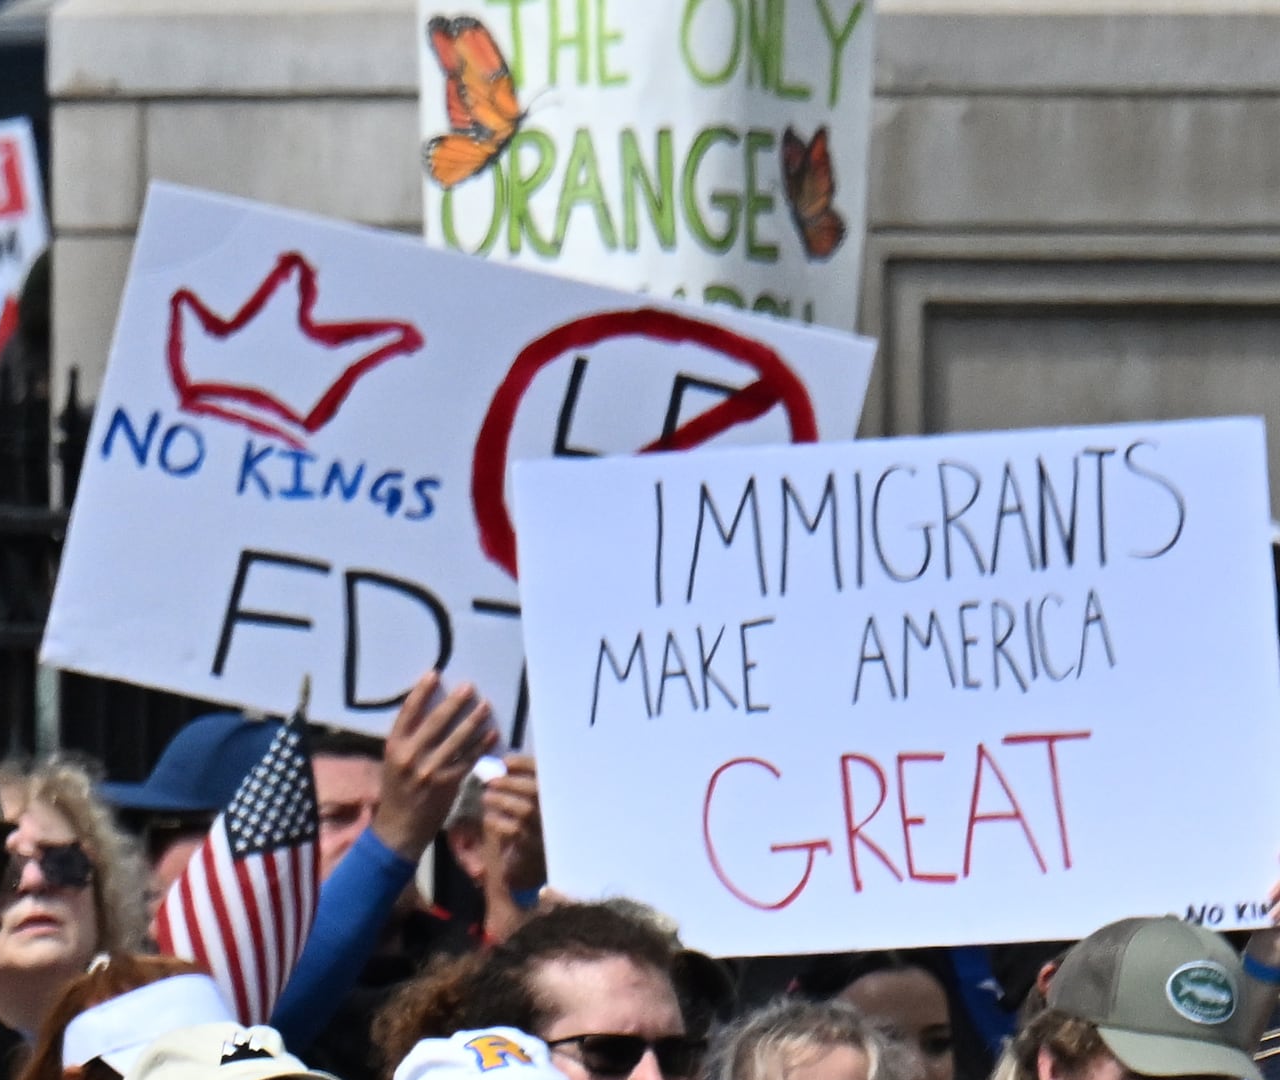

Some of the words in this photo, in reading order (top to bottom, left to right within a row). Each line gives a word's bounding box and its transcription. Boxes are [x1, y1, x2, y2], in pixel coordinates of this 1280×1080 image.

[483, 0, 630, 90] THE
[681, 0, 864, 108] ONLY
[440, 125, 782, 260] ORANGE
[101, 407, 206, 477] NO
[239, 438, 442, 522] KINGS
[653, 440, 1186, 608] IMMIGRANTS
[590, 614, 776, 728] MAKE
[851, 588, 1118, 706] AMERICA
[703, 730, 1092, 911] GREAT
